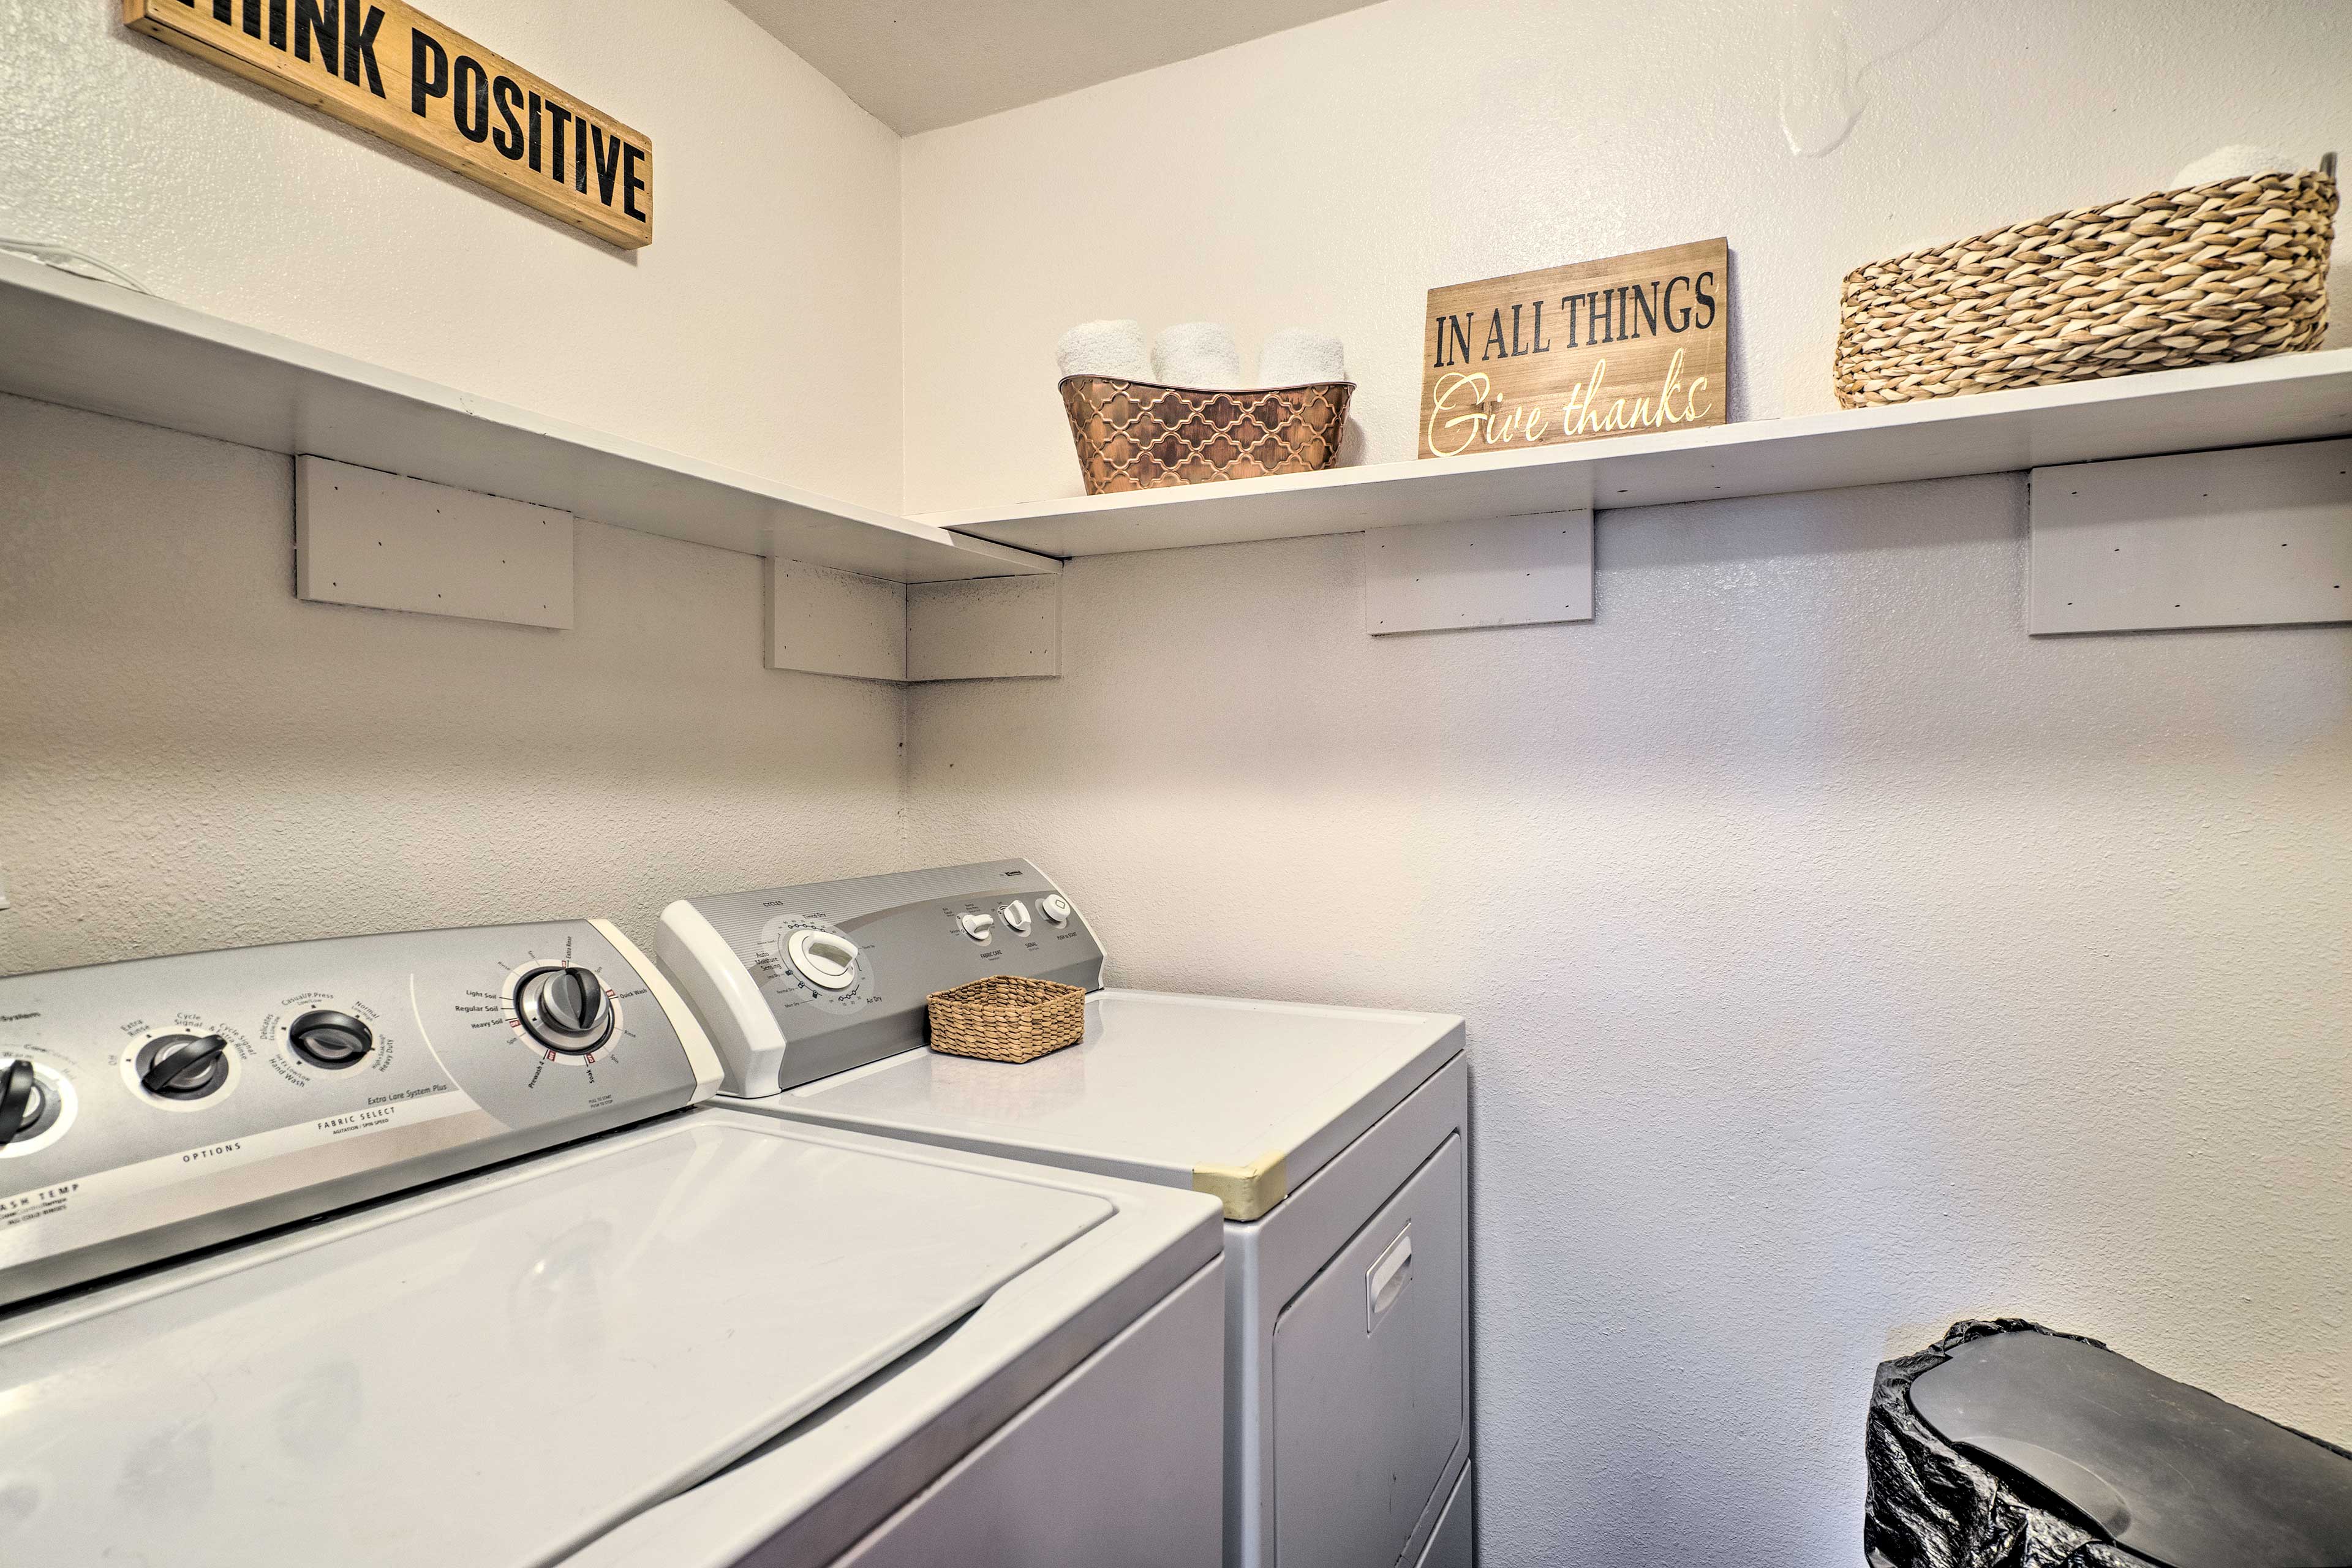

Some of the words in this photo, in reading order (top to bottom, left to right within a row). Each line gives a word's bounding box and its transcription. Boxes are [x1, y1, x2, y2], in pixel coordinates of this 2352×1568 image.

[176, 0, 386, 99] INK
[412, 27, 647, 224] POSITIVE
[1434, 312, 1474, 368] IN
[1482, 300, 1550, 361] ALL
[1561, 271, 1716, 349] THINGS
[1428, 372, 1548, 458] Give
[1563, 347, 1713, 436] thanks
[355, 1001, 380, 1019] Normal
[238, 1035, 257, 1055] Signal
[269, 1058, 285, 1075] Hand
[285, 1073, 305, 1087] Wash
[379, 1055, 393, 1072] Heavy
[528, 1066, 543, 1088] Prewash
[586, 1069, 595, 1084] Soak
[368, 1095, 386, 1105] Extra
[406, 1087, 431, 1098] System
[432, 1084, 447, 1092] Plus
[318, 1116, 355, 1130] FABRIC
[360, 1107, 396, 1120] SELECT
[333, 1125, 358, 1134] AGITATION
[183, 1142, 241, 1163] OPTIONS
[39, 1183, 78, 1200] TEMP
